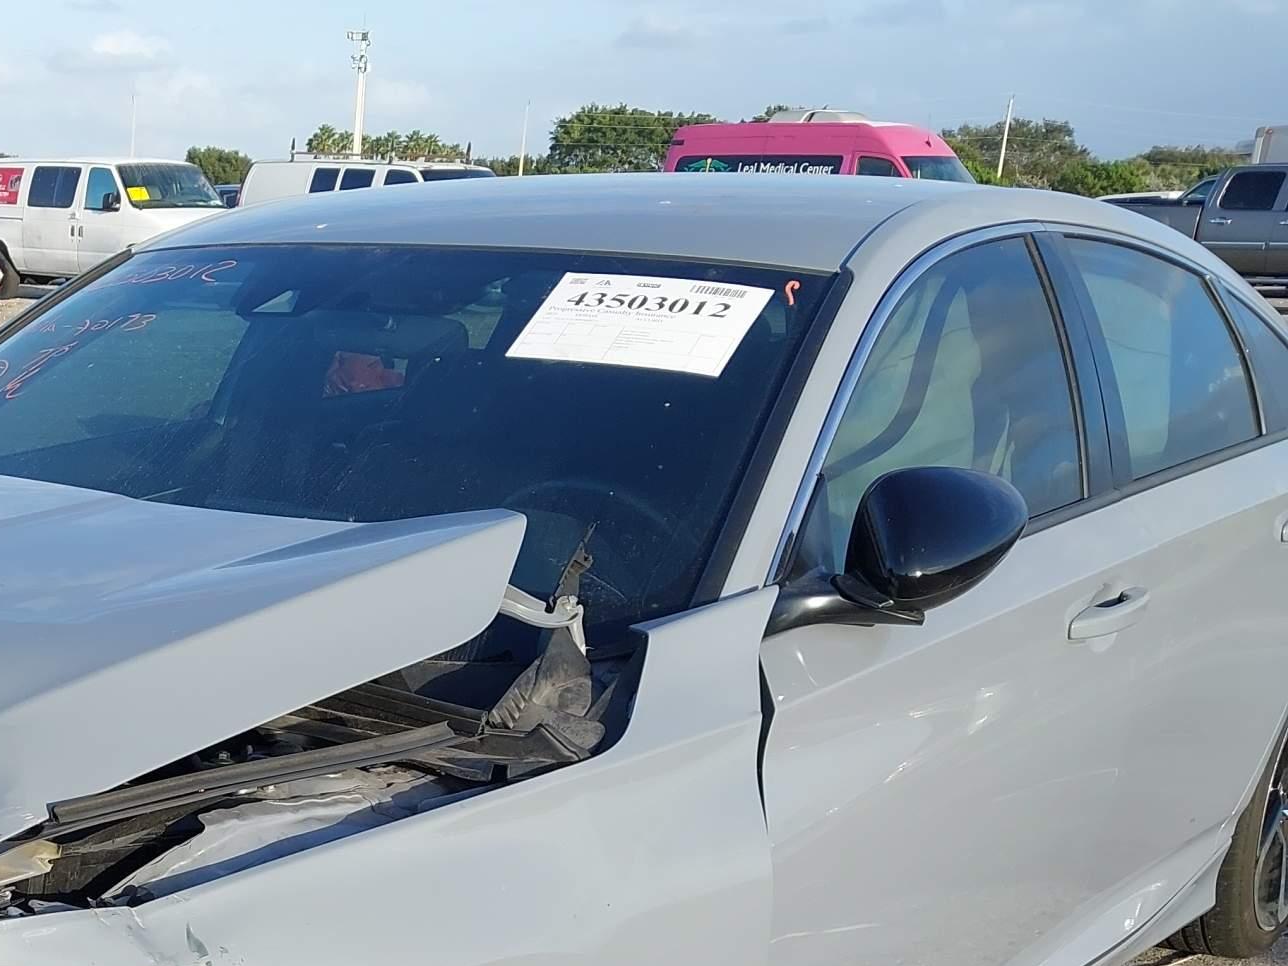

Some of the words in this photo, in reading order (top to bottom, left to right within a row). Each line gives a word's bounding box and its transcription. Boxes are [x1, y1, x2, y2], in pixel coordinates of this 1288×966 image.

[738, 162, 757, 174] Leal
[759, 162, 797, 175] Medical
[799, 163, 834, 176] Center
[567, 291, 731, 318] 43503012
